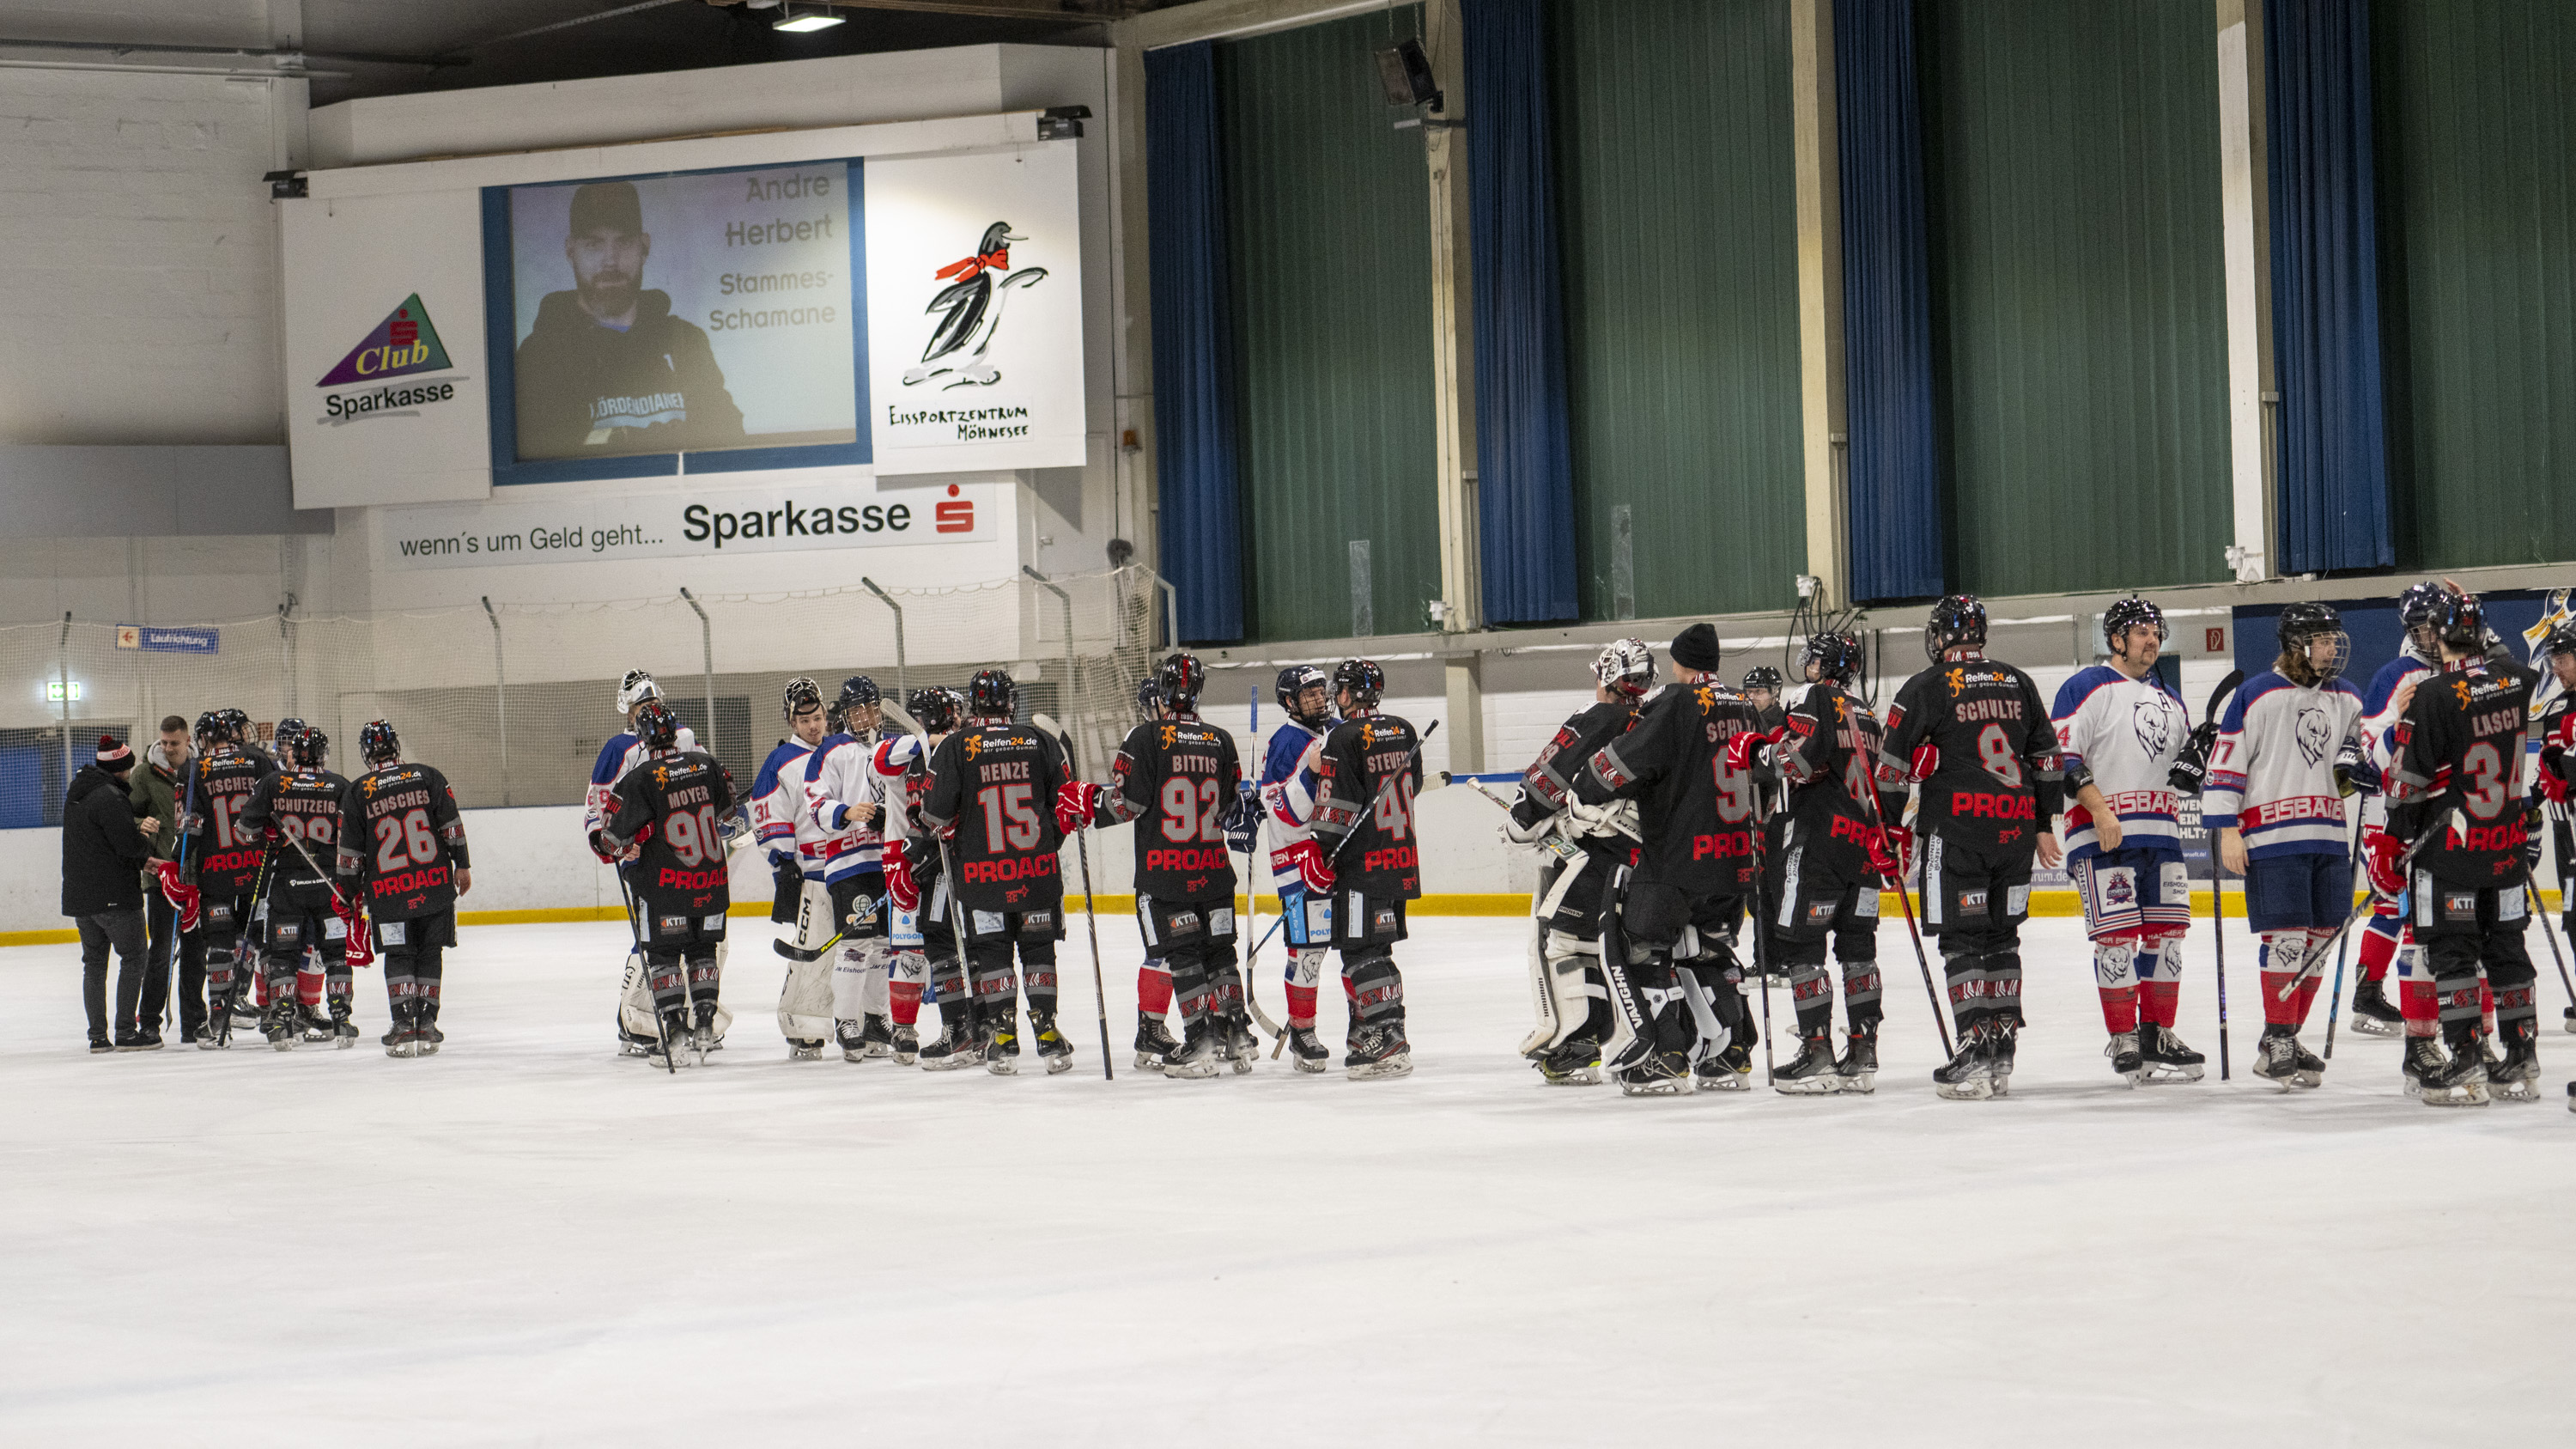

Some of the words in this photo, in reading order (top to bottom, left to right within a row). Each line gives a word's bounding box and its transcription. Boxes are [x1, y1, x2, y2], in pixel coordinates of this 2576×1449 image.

[745, 174, 830, 204] Andre
[725, 214, 833, 247] Herbert
[720, 271, 834, 295] Stammes-
[709, 306, 836, 332] Schamane
[355, 339, 428, 374] Club
[326, 384, 454, 420] Sparkasse
[683, 500, 912, 549] Sparkasse
[487, 534, 522, 551] um
[530, 526, 583, 550] Geld
[591, 524, 664, 552] geht...
[150, 633, 209, 646] Laufrichtung
[2465, 657, 2481, 667] 1996
[1965, 672, 2018, 683] Reifen24.de
[2470, 677, 2522, 697] Reifen24.de
[1956, 698, 2021, 722] SCHULTE
[2158, 692, 2172, 710] A
[2473, 707, 2521, 738] LASCH
[983, 737, 1037, 749] Reifen24.de
[1978, 722, 2022, 788] 8
[2209, 740, 2235, 765] 17
[980, 761, 1030, 783] HENZE
[1172, 755, 1218, 773] BITTIS
[2464, 732, 2527, 819] 34
[668, 785, 710, 809] MOYER
[1161, 776, 1225, 843] 92
[1952, 792, 2035, 820] PROAC
[755, 801, 772, 825] 31
[977, 782, 1042, 854] 15
[374, 808, 438, 874] 26
[665, 804, 722, 868] 90
[203, 849, 265, 873] PROAC
[963, 852, 1057, 884] PROACT
[1146, 848, 1230, 871] PROAC
[372, 868, 448, 898] PROACT
[659, 867, 728, 890] PROAC
[798, 897, 811, 946] CCM
[1029, 913, 1051, 924] KTM
[1558, 906, 1583, 917] BROWN
[2085, 908, 2093, 926] JM
[1538, 977, 1549, 1017] WARRIOR
[1611, 965, 1643, 1029] VAUGHN
